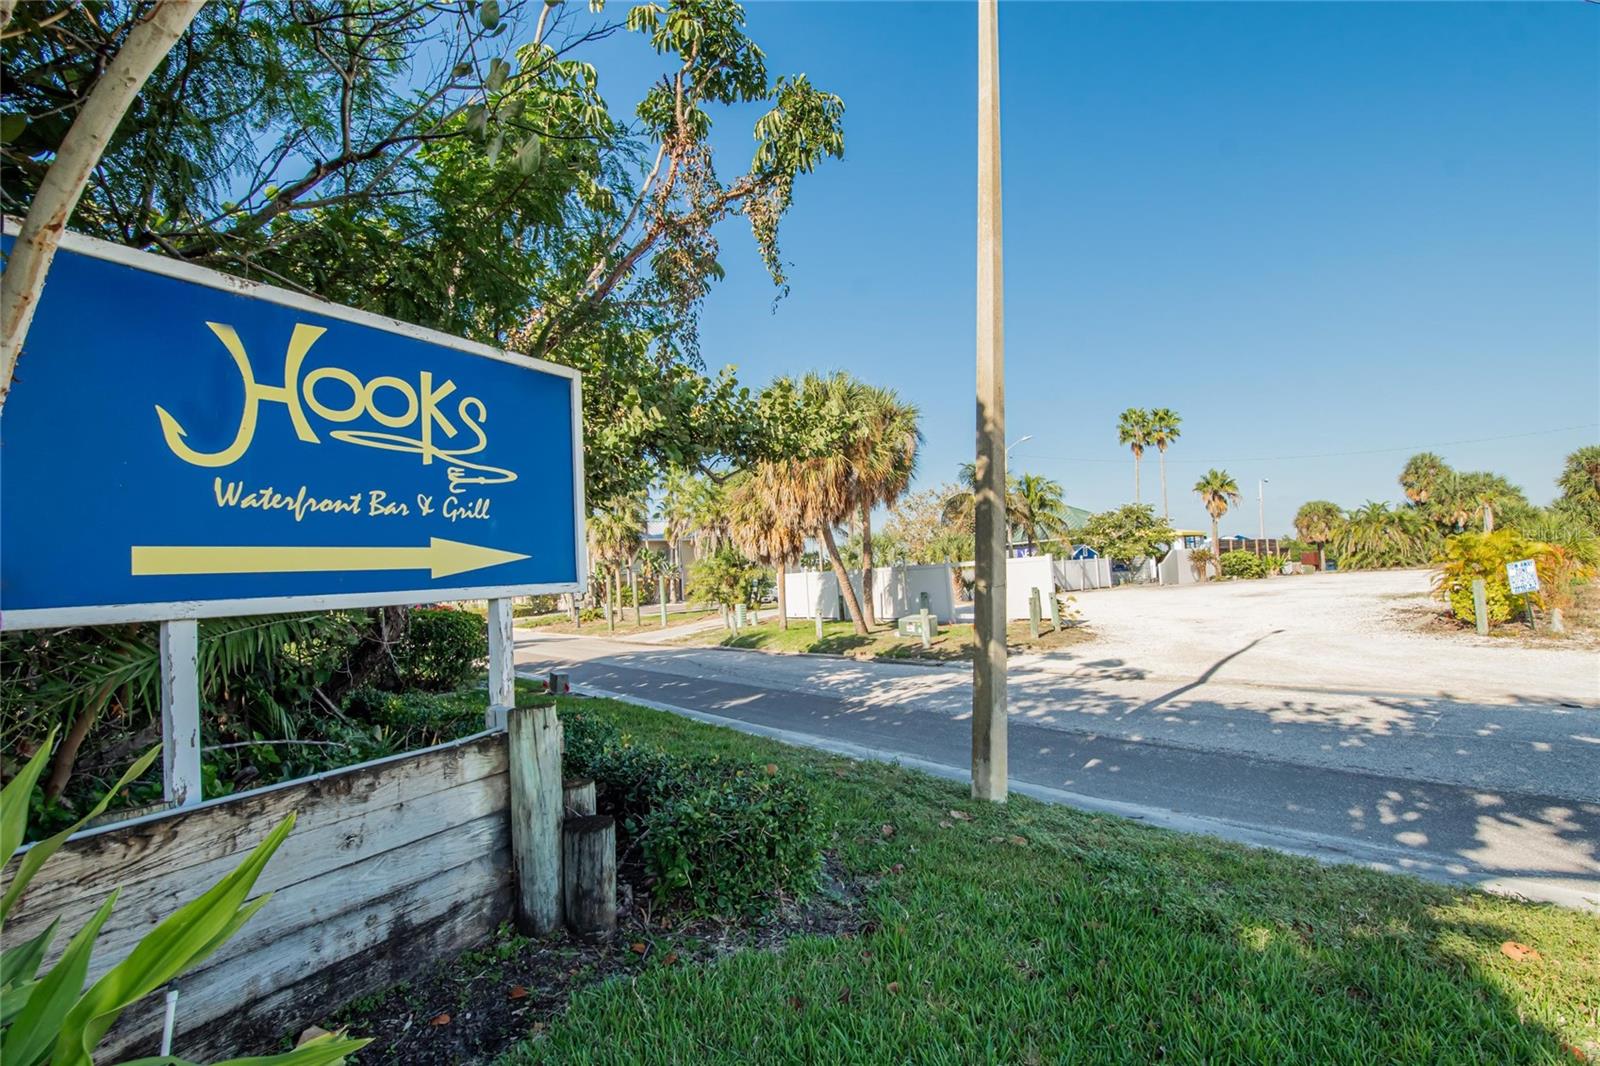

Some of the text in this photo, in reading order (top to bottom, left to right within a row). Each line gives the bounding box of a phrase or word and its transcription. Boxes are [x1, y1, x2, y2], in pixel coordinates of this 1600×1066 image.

[214, 476, 490, 522] Waterfront Bar & Grill
